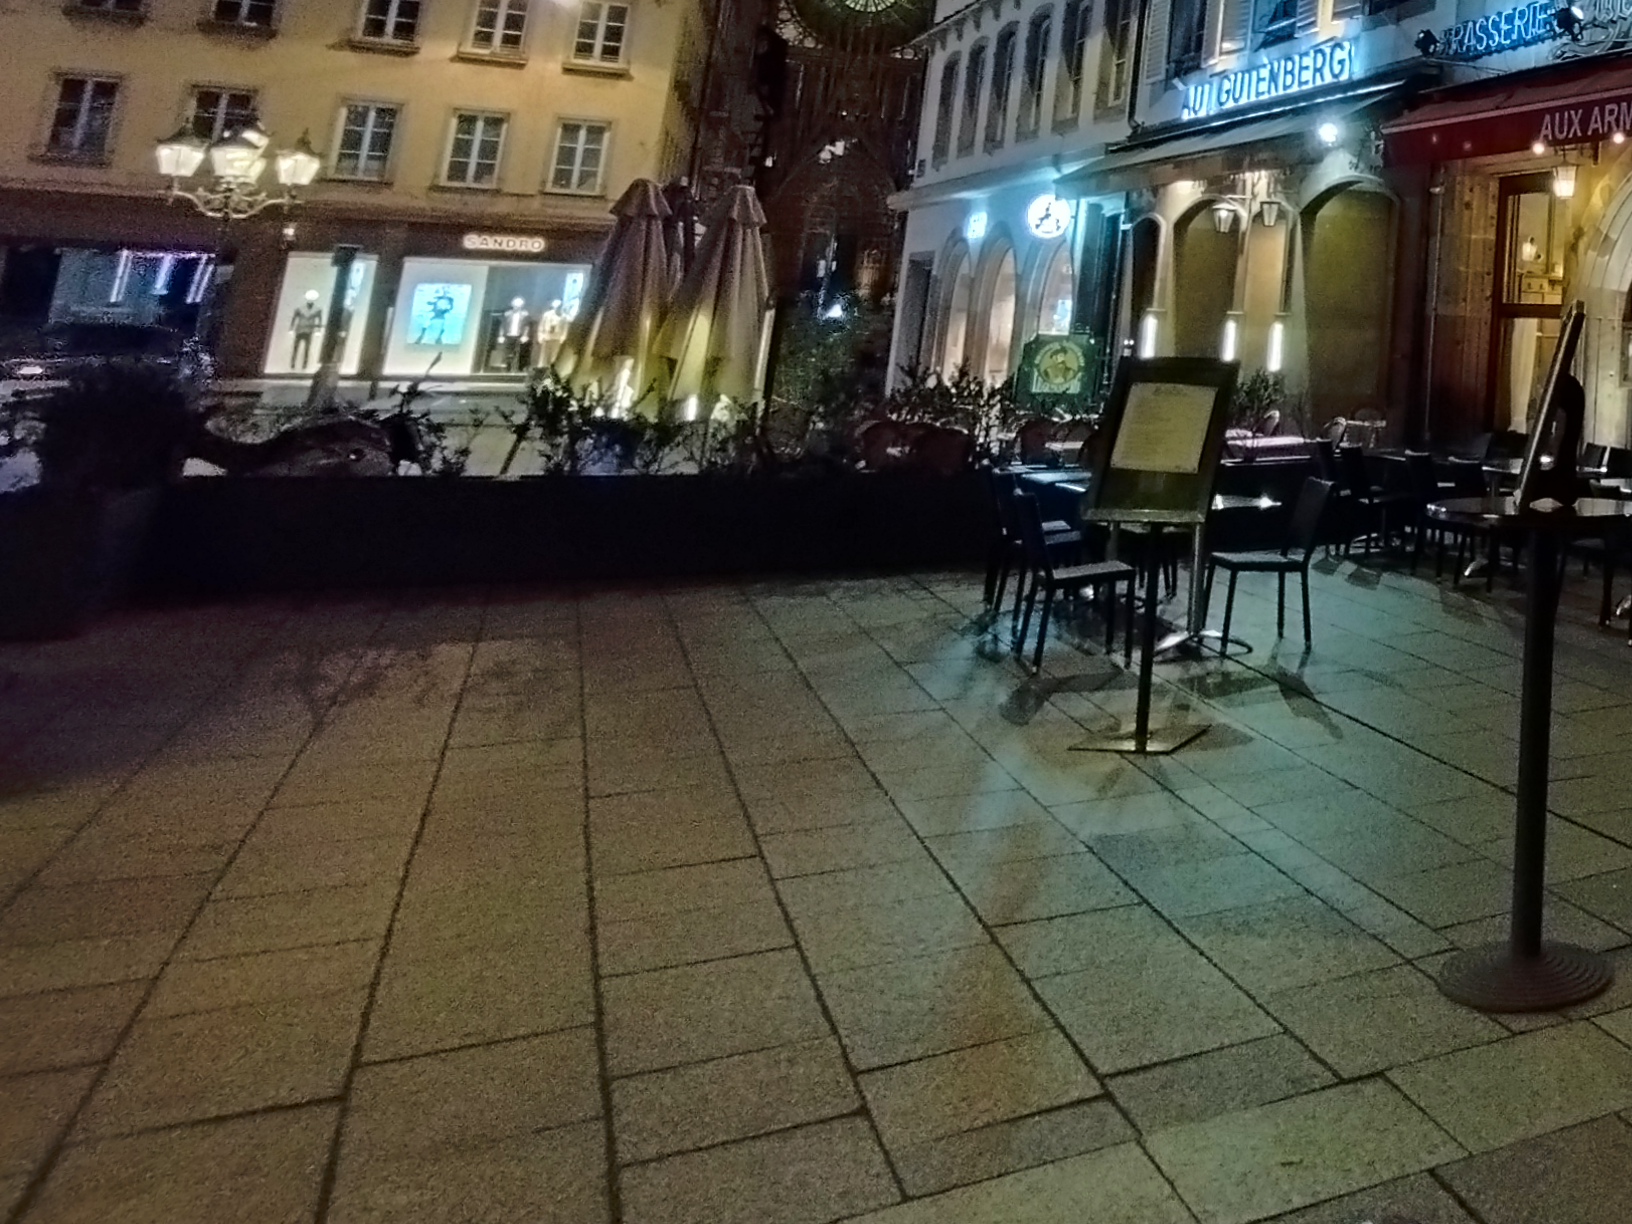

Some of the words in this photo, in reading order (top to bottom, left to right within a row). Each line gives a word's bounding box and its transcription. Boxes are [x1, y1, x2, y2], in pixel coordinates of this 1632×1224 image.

[1181, 82, 1207, 121] AU
[1217, 41, 1347, 108] GUTENBERG
[1539, 108, 1583, 141] AUX
[464, 232, 545, 253] SANDRO
